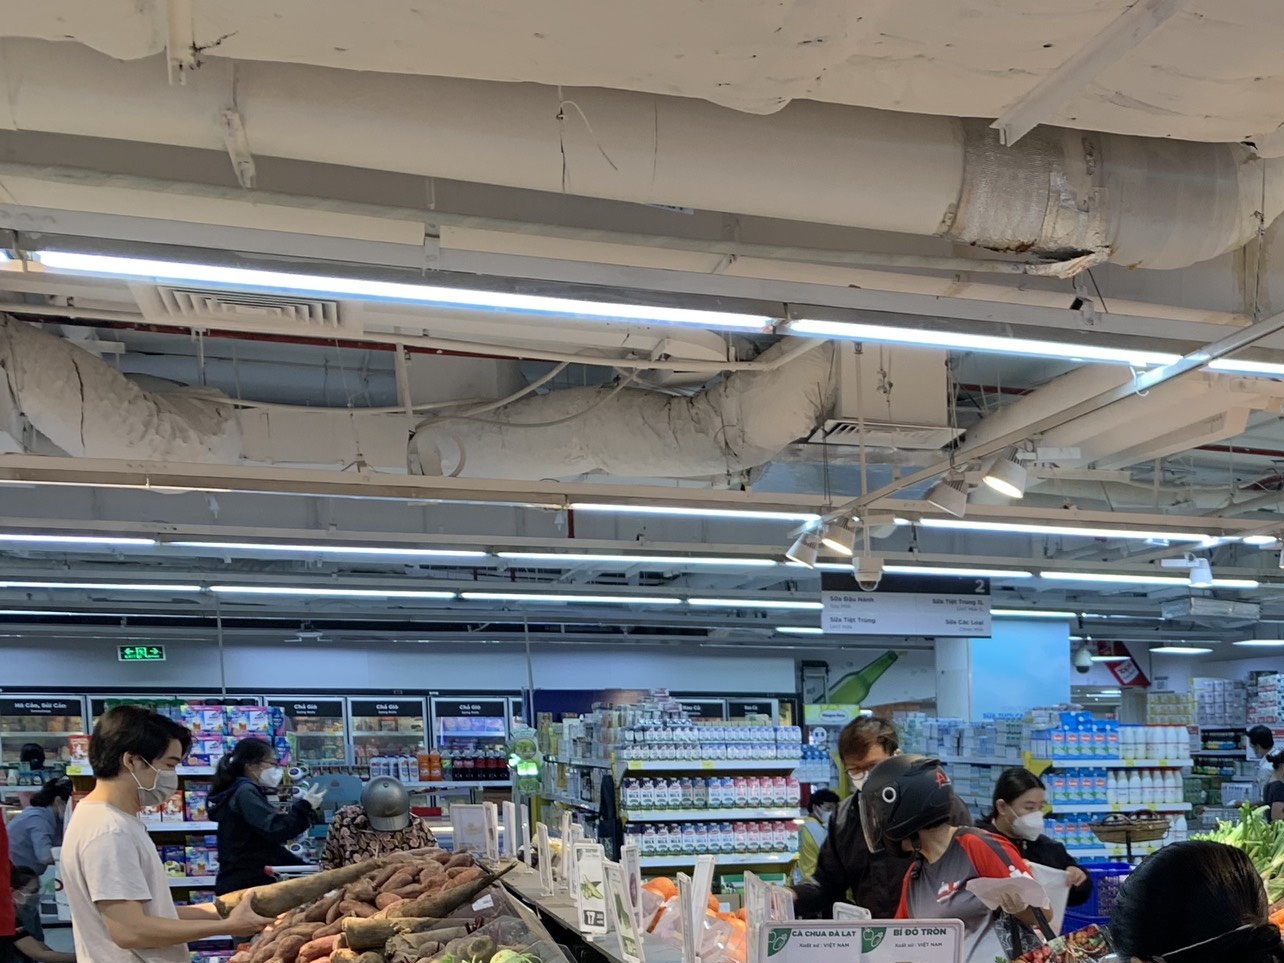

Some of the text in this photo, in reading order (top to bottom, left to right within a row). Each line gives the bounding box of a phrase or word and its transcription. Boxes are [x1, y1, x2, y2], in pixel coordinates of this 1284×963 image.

[975, 579, 986, 593] 2
[586, 911, 596, 925] 17
[893, 926, 902, 936] BÍ
[921, 926, 946, 936] TRÒN
